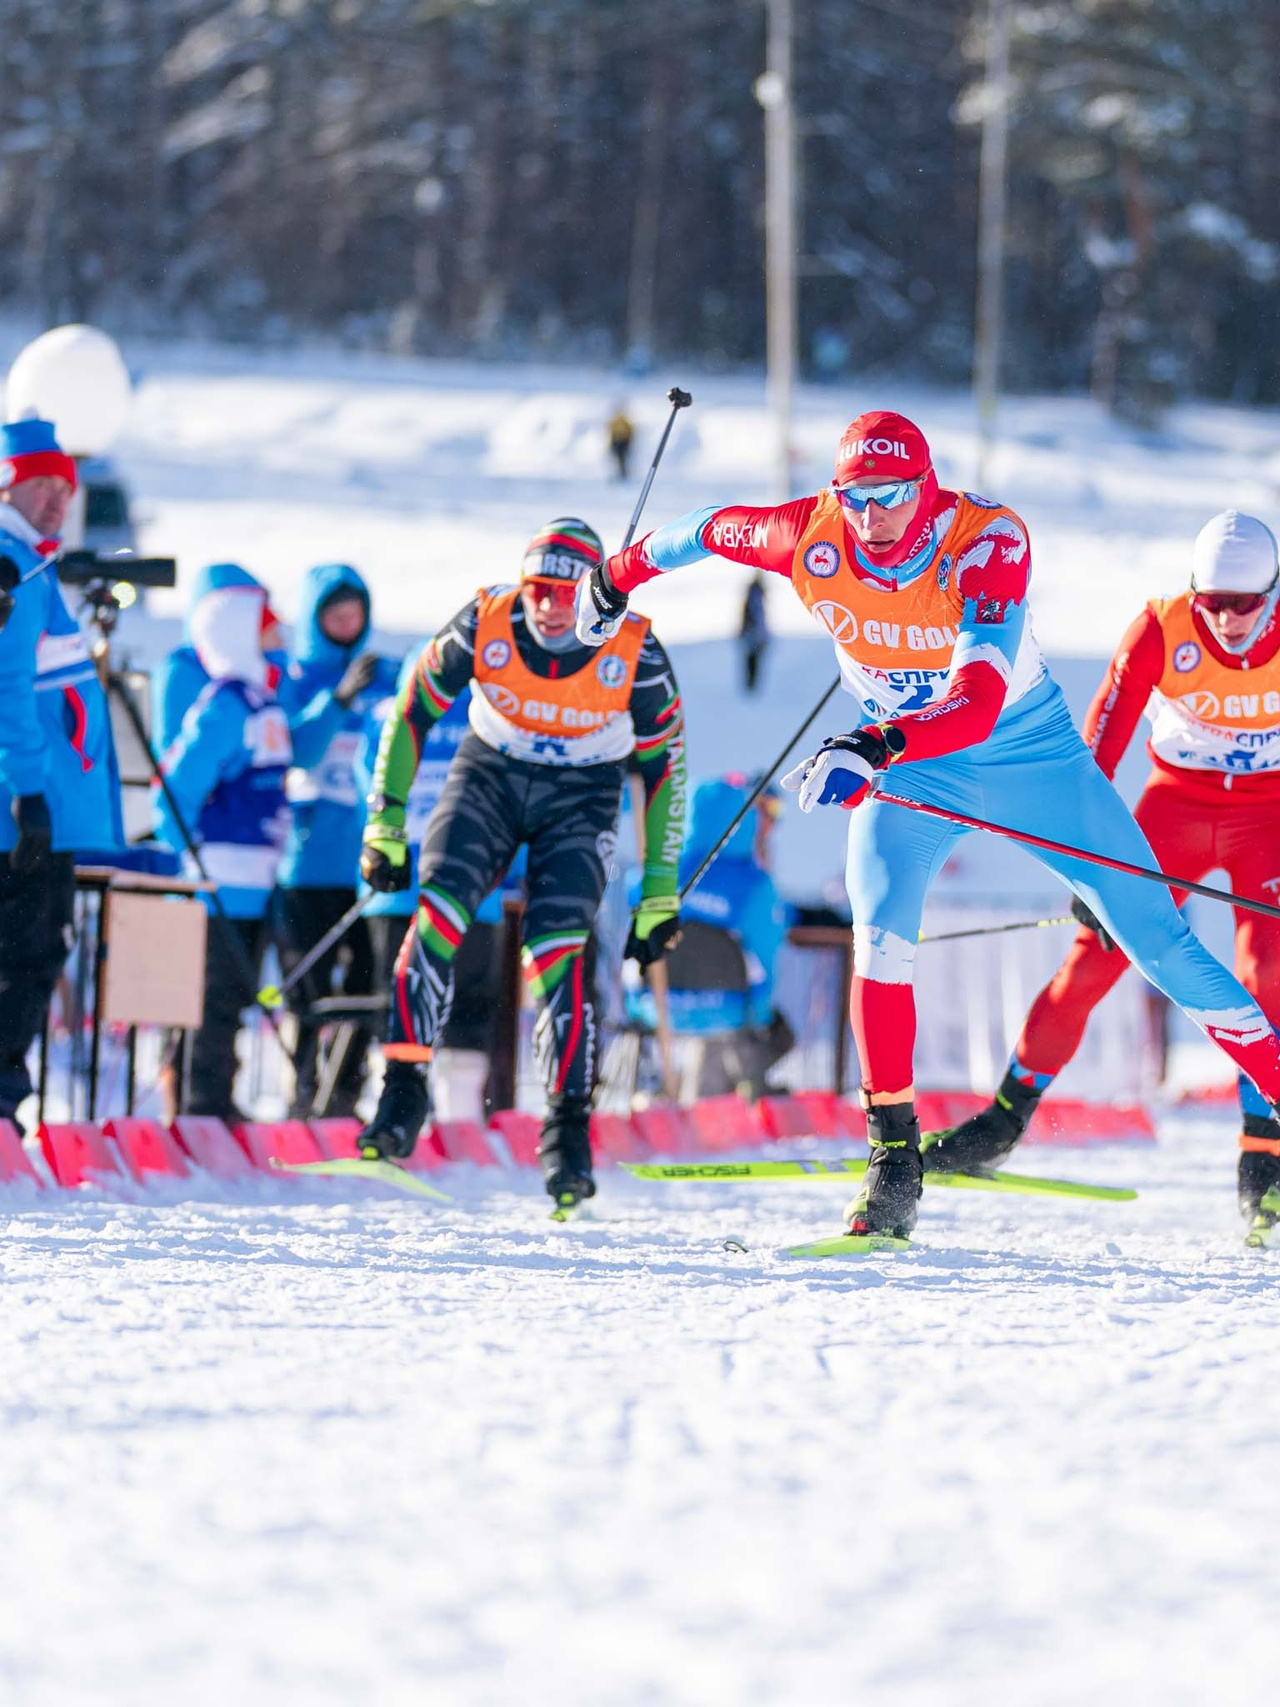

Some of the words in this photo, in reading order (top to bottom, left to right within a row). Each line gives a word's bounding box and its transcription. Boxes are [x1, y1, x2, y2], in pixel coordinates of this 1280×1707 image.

[863, 620, 900, 648] GV
[906, 625, 960, 650] GOL
[889, 684, 938, 710] 2
[1223, 694, 1260, 718] GV
[522, 699, 560, 723] GV
